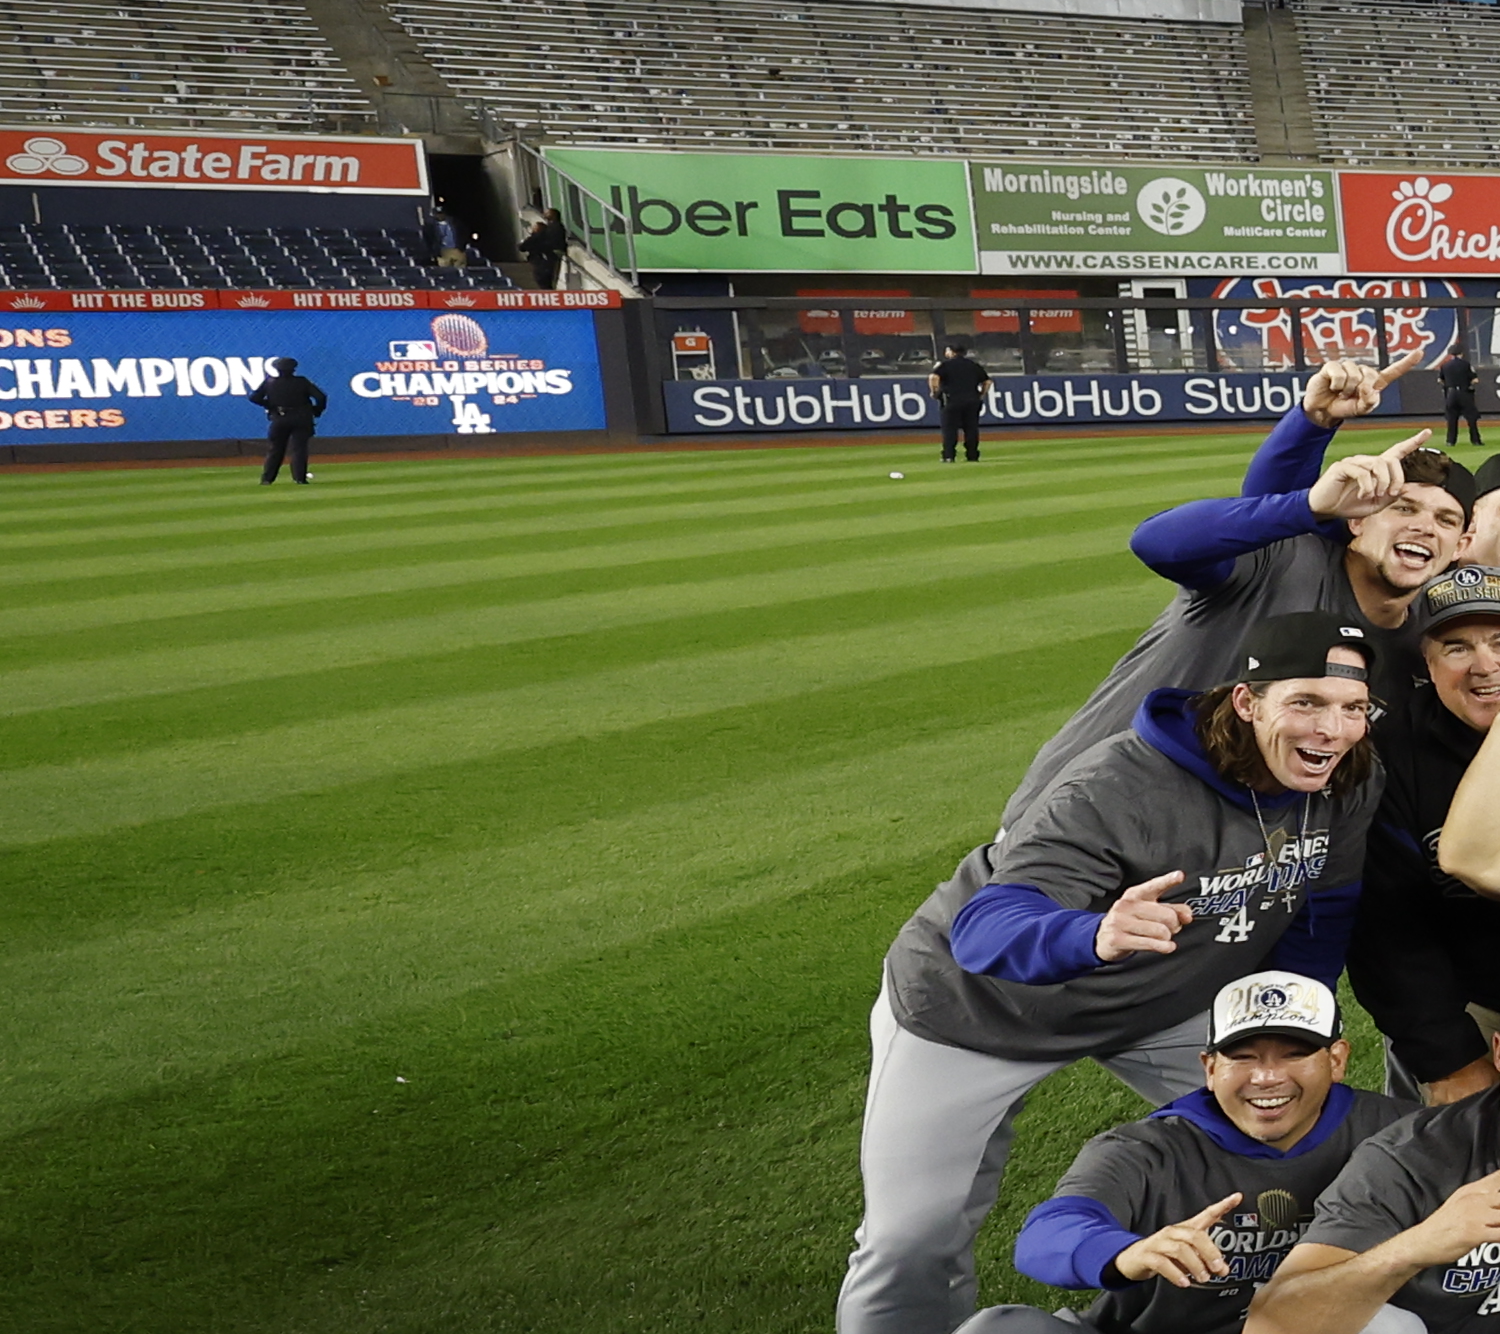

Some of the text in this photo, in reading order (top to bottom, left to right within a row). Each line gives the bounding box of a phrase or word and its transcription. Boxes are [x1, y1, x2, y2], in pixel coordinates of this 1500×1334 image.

[983, 168, 1128, 198] Morningside
[1205, 172, 1324, 198] Workmen's
[569, 186, 956, 240] Uber Eats
[1052, 210, 1130, 225] Nursing and
[1261, 198, 1324, 222] Circle
[991, 223, 1131, 236] Rehabilitation Center
[1224, 225, 1328, 239] MultiCare Center
[1008, 254, 1318, 270] WWW.CASSENACARE.COM
[72, 293, 204, 308] HIT THE BUDS
[350, 370, 573, 397] CHAMPIONS
[693, 384, 926, 427] StubHub
